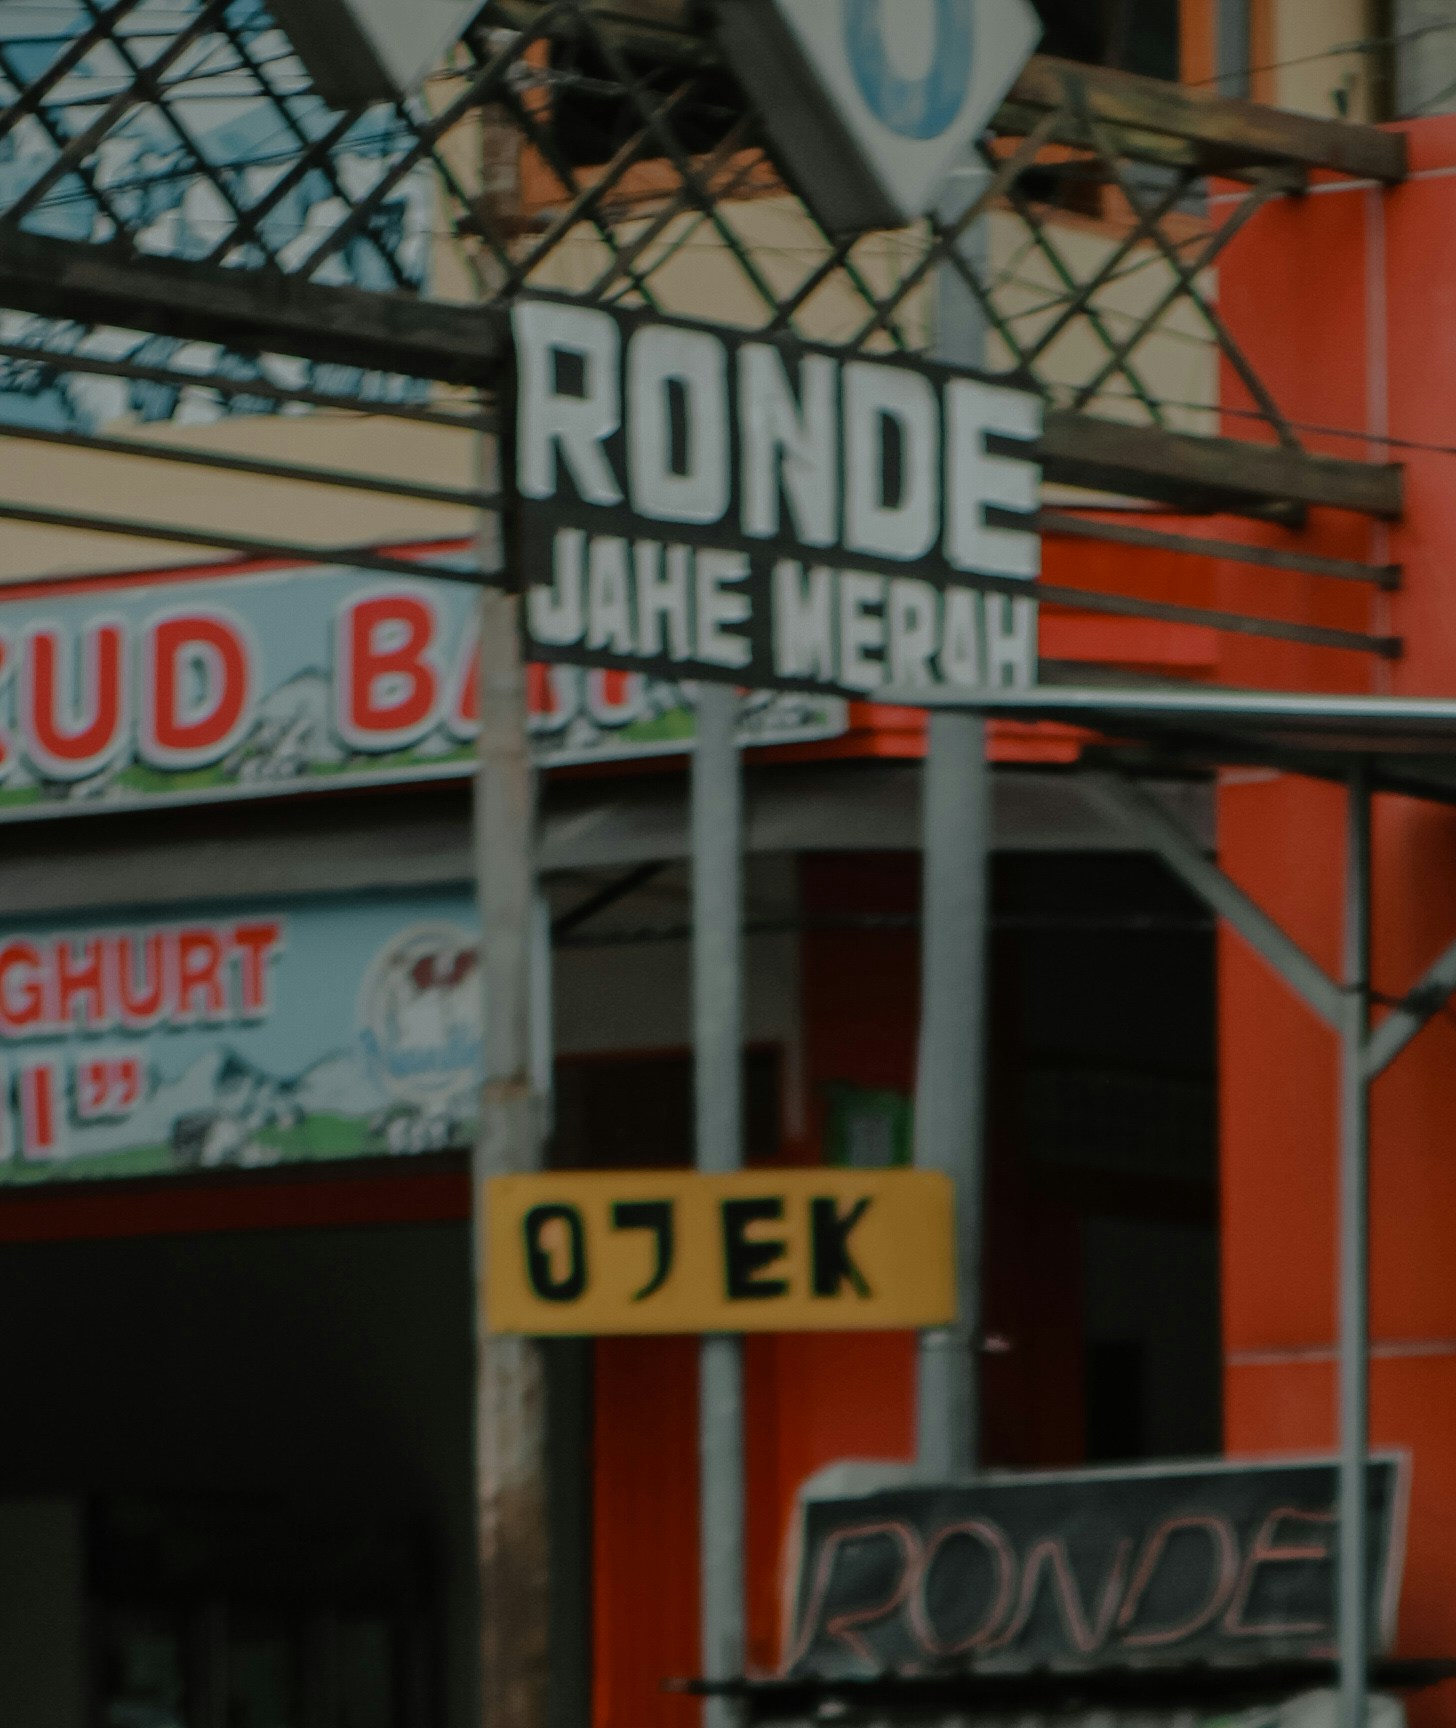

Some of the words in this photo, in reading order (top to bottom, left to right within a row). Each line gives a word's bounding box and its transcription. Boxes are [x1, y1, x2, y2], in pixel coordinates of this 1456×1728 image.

[511, 300, 1044, 580] RONDE
[0, 612, 252, 768] UD
[528, 527, 753, 671] JAHE
[770, 556, 1040, 693] MERAH
[784, 1506, 1340, 1677] RONDE
